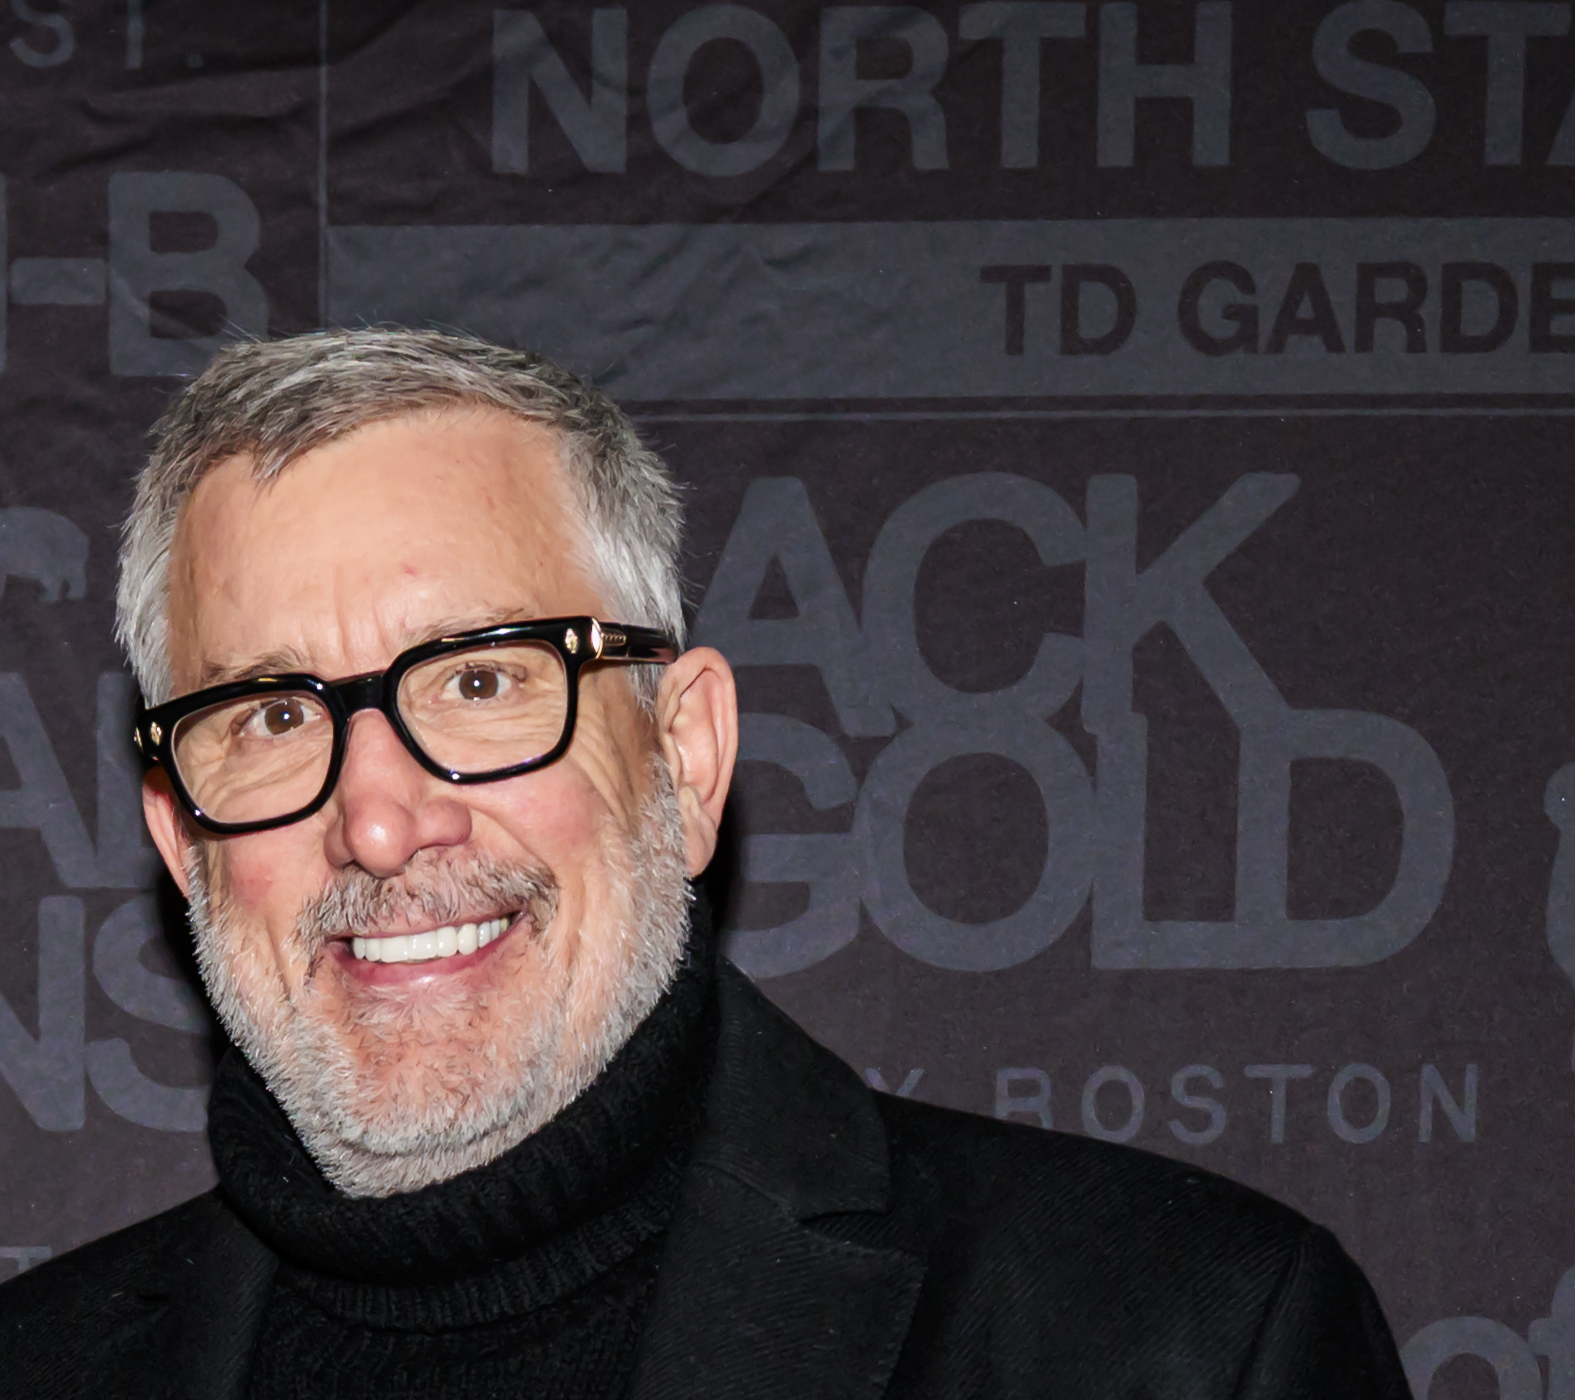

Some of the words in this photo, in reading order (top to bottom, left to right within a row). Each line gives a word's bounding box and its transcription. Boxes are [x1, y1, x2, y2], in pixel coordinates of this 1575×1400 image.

[489, 2, 1232, 175] NORTH
[979, 262, 1138, 356] TD
[992, 1063, 1481, 1146] BOSTON
